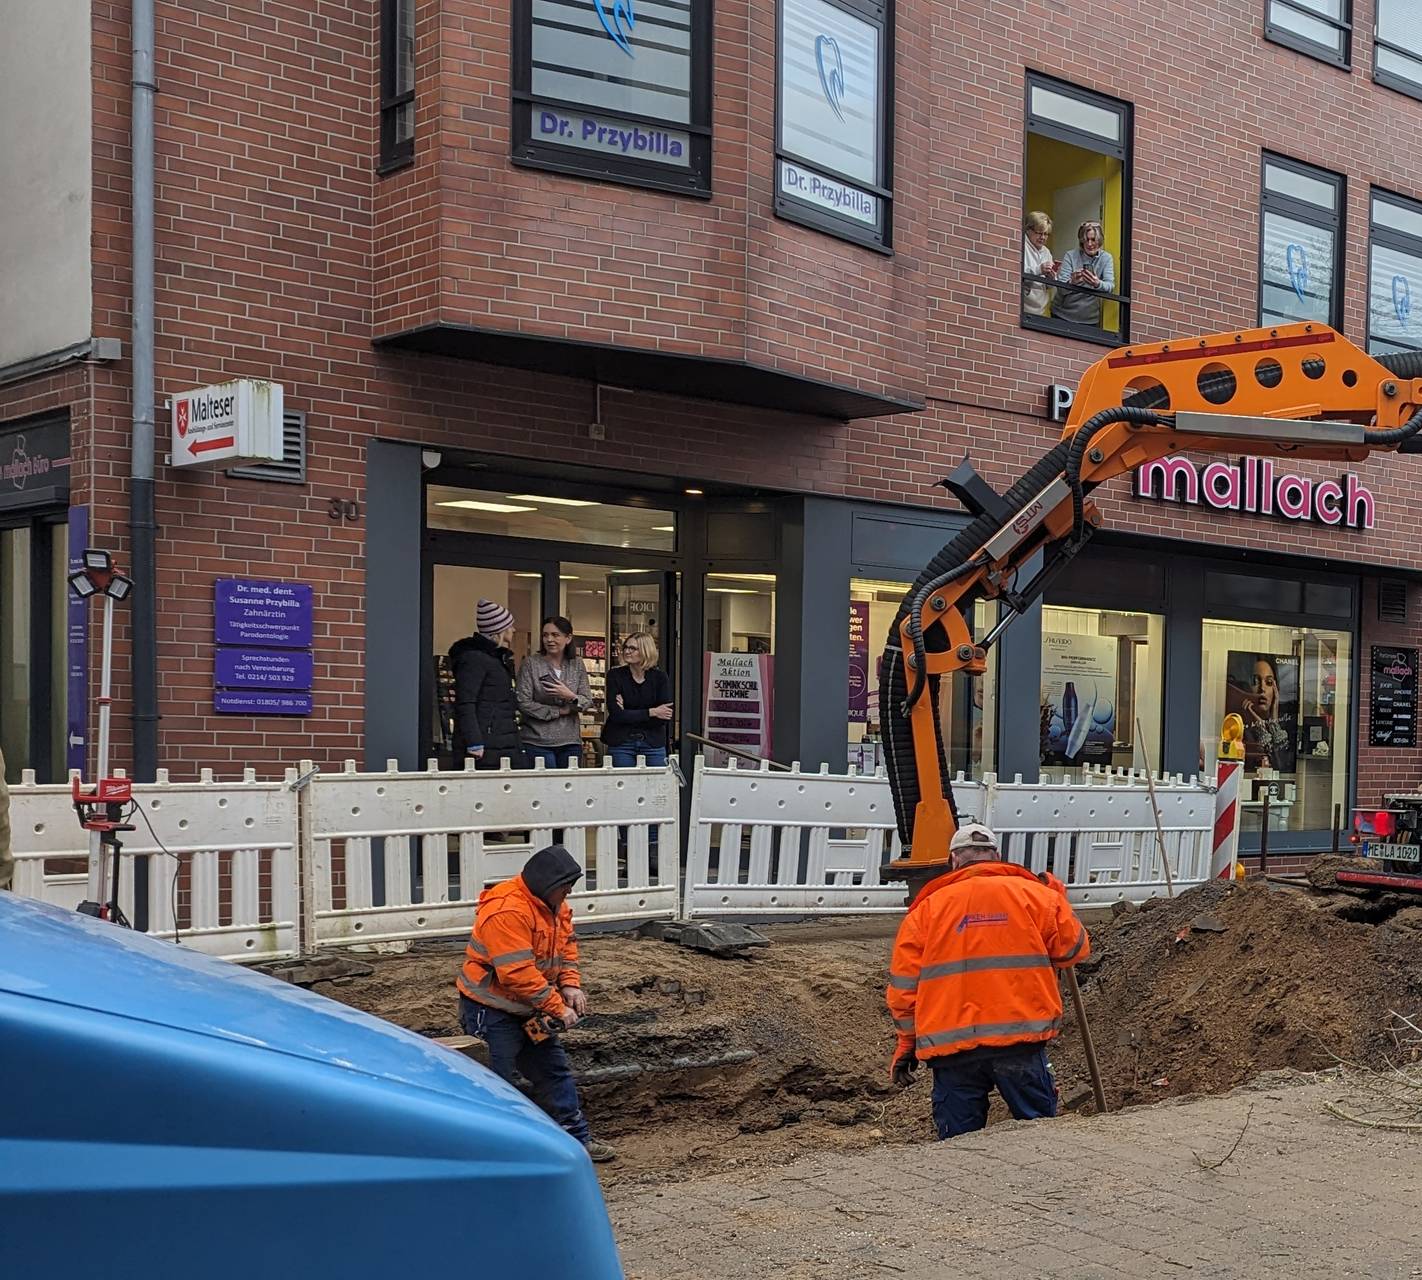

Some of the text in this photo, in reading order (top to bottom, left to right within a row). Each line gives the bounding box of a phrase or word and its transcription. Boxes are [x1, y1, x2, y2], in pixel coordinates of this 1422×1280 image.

[540, 111, 683, 158] Dr. Przybilla
[786, 167, 872, 214] Dr. Przybilla
[192, 394, 235, 423] Malteser
[1137, 455, 1376, 530] mallach
[237, 584, 295, 596] Dr. med. dent.
[229, 596, 300, 608] Susanne Przybilla
[244, 608, 286, 618] Zahnärztin
[717, 658, 753, 668] Mallach
[1275, 658, 1299, 666] CHANEL
[720, 668, 751, 677] Aktion
[1384, 846, 1395, 858] LA
